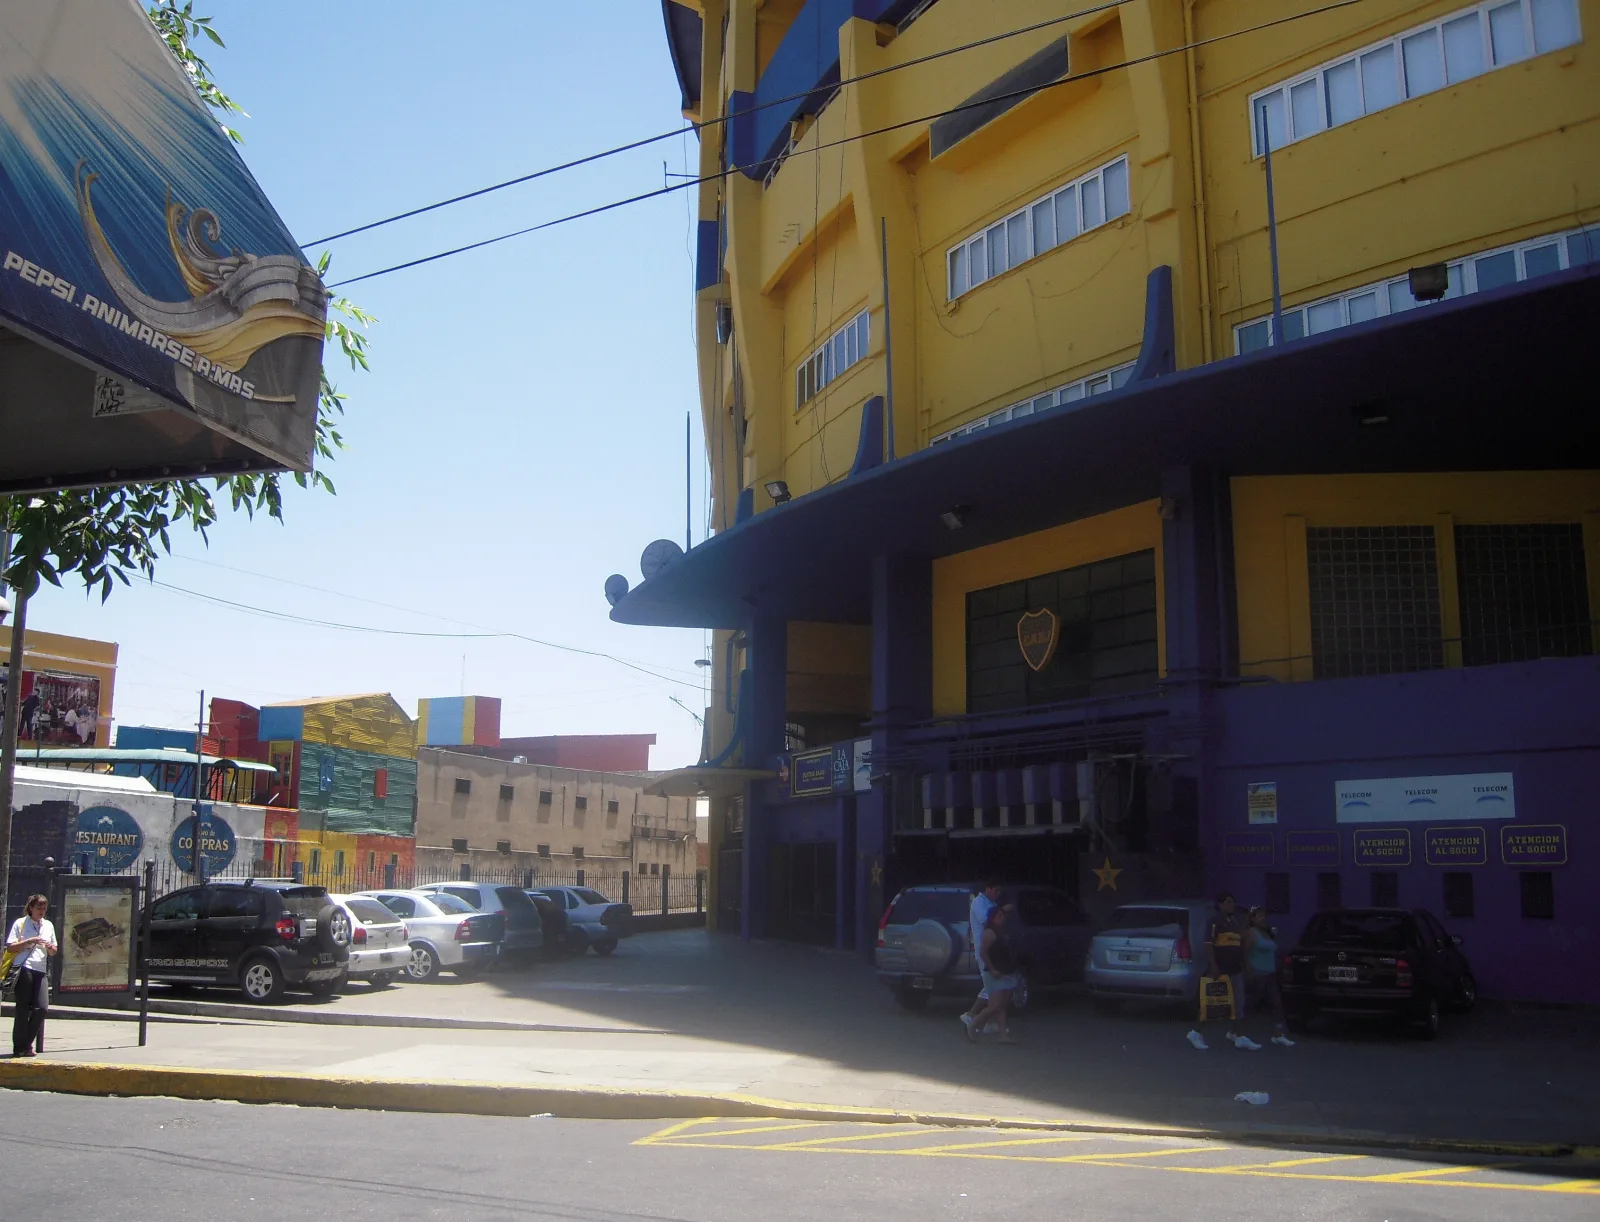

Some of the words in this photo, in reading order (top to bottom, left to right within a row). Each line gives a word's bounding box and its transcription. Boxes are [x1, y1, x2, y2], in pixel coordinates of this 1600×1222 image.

[82, 293, 195, 368] ANIMARSE
[1473, 785, 1508, 793] TELECOM
[179, 837, 229, 851] COPRAS
[1359, 839, 1406, 847] ATENCION
[1431, 837, 1480, 846] ATENCION
[1508, 835, 1560, 845] ATENCION
[1363, 847, 1376, 856] AL
[1377, 847, 1403, 856] SOCIO
[1435, 847, 1447, 855] AL
[1450, 847, 1477, 855] SOCIO
[1512, 845, 1524, 854] AL
[1528, 845, 1557, 854] SOCIO
